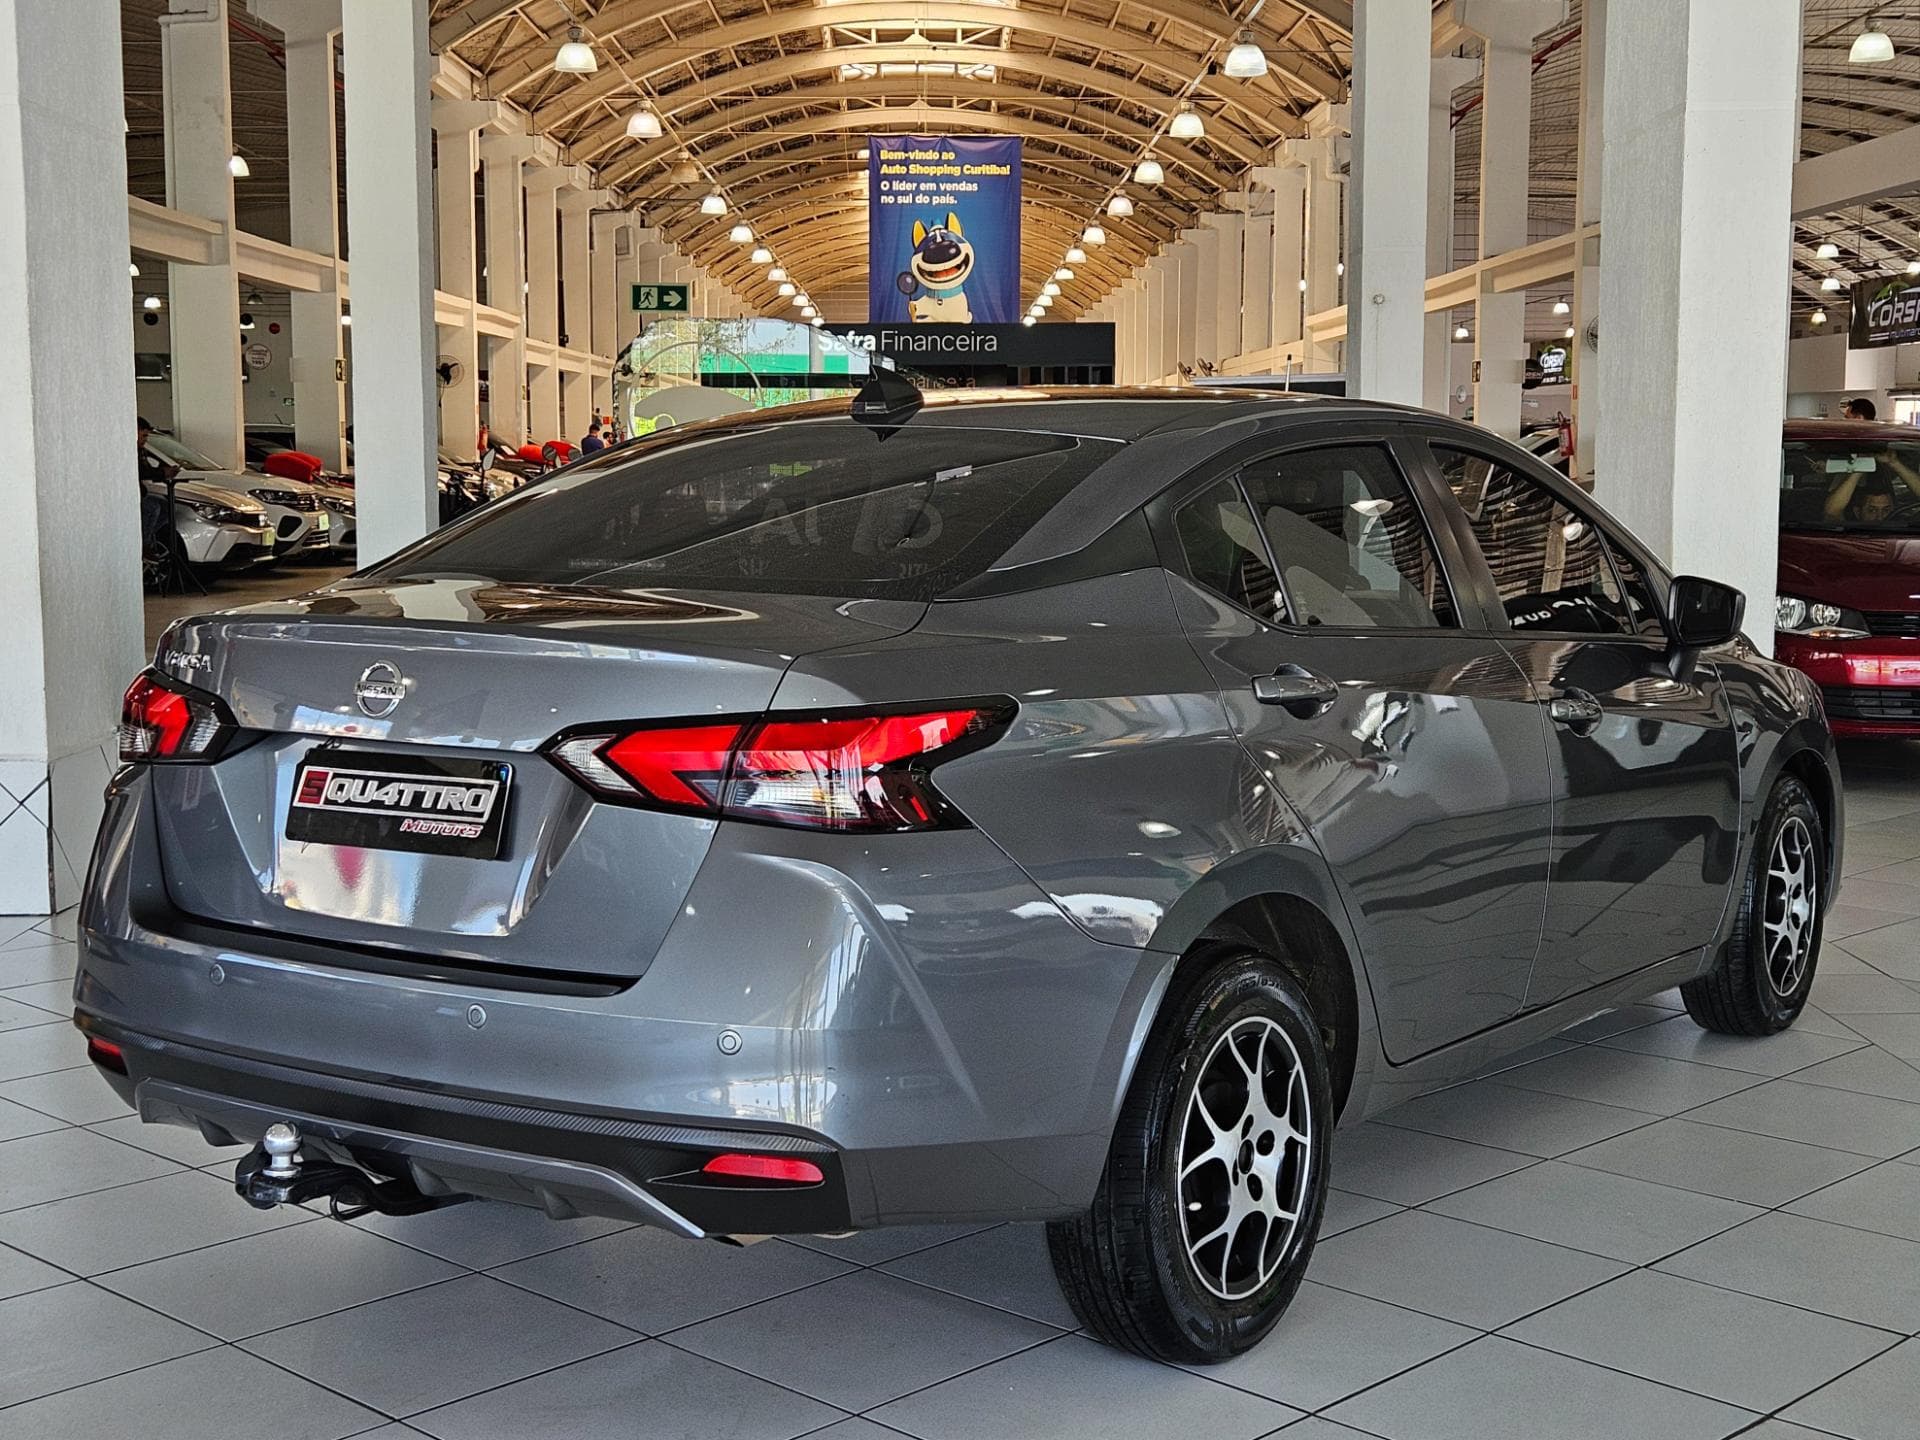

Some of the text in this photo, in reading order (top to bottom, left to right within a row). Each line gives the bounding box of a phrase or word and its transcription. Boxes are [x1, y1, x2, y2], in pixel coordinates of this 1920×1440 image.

[880, 150, 955, 160] Bem-vindo ao
[880, 164, 1010, 176] Auto Shopping Curitiba!
[881, 180, 978, 191] O líder em vendas
[881, 193, 957, 205] no sul do país.
[818, 330, 997, 352] Safra Financeira
[358, 684, 398, 695] NISSAN
[400, 819, 483, 838] MOTORS
